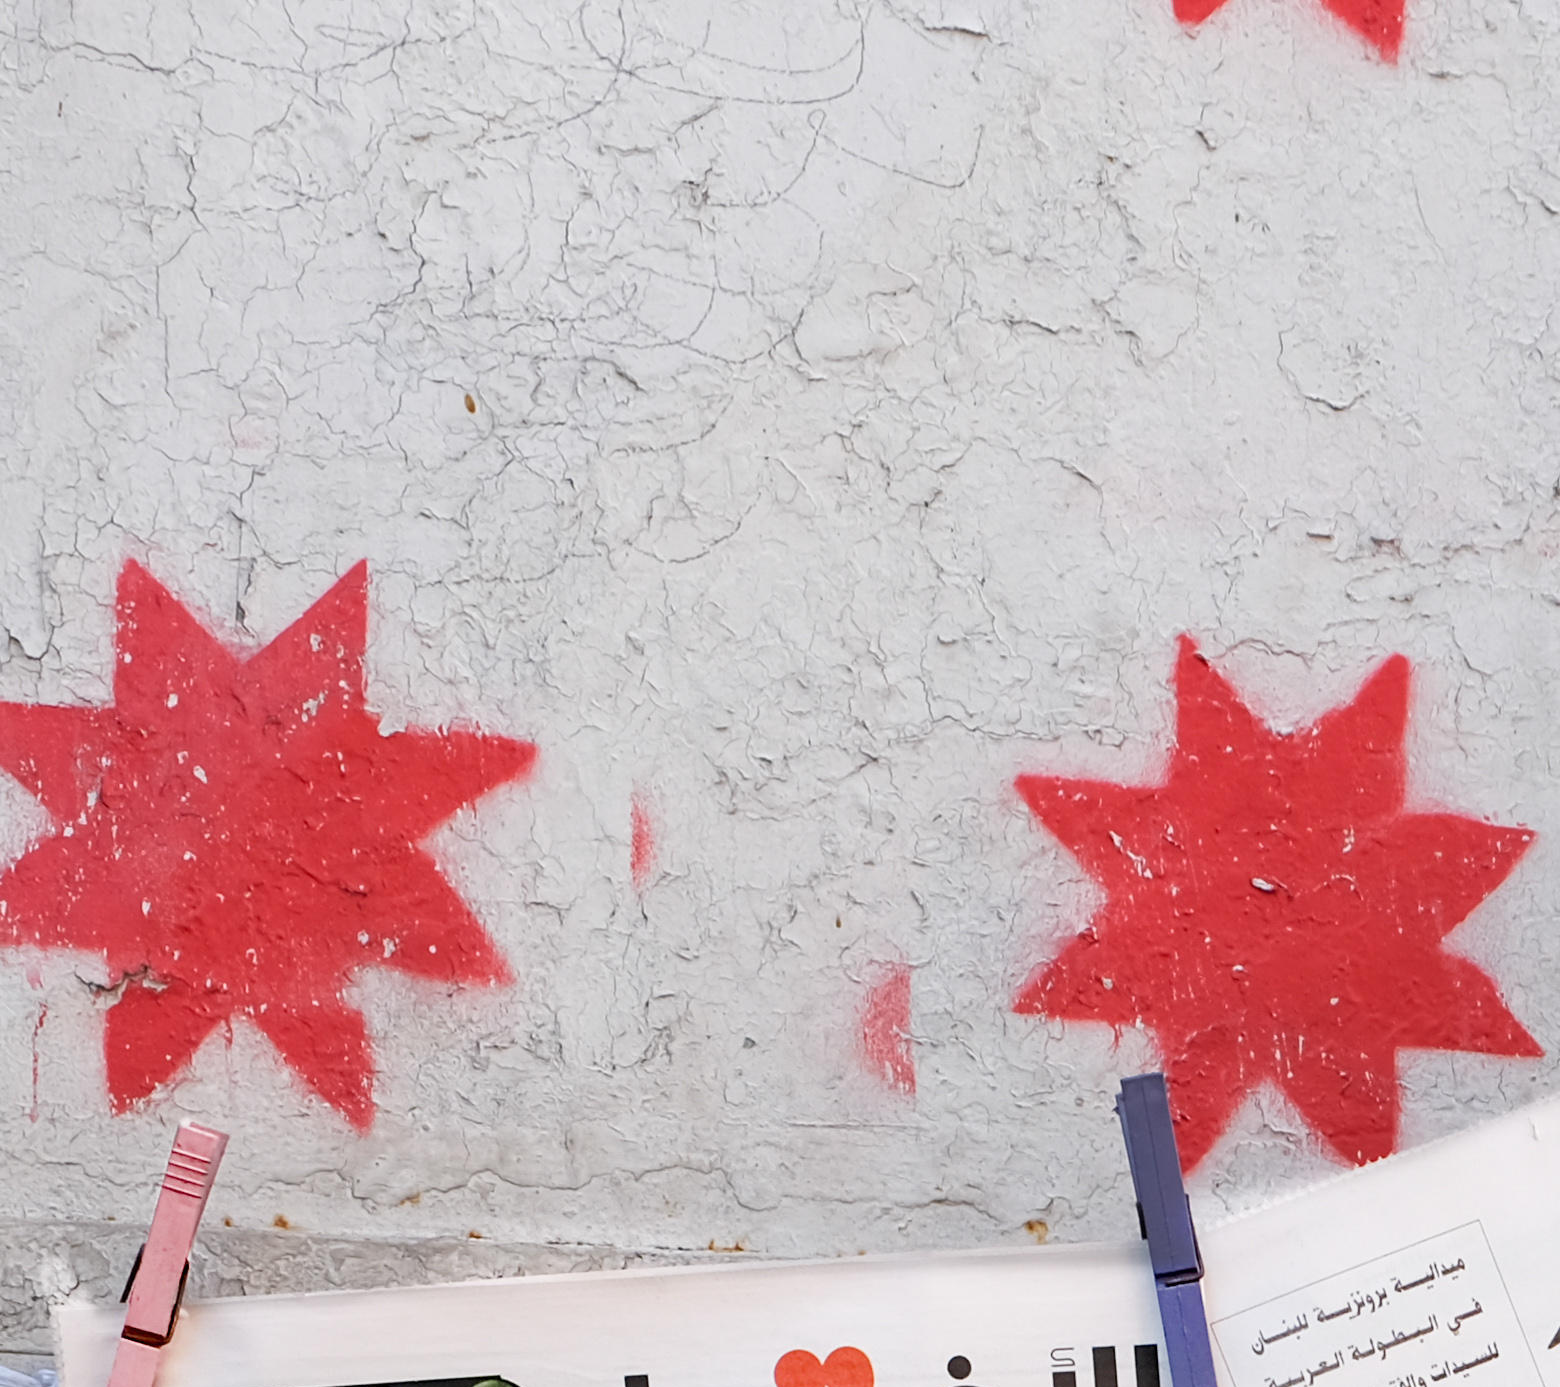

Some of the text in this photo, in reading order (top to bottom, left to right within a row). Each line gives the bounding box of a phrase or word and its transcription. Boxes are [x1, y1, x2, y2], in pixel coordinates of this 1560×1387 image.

[1347, 1313, 1439, 1361] البطولة
[1446, 1297, 1484, 1336] في
[1430, 1341, 1500, 1382] للسيدات
